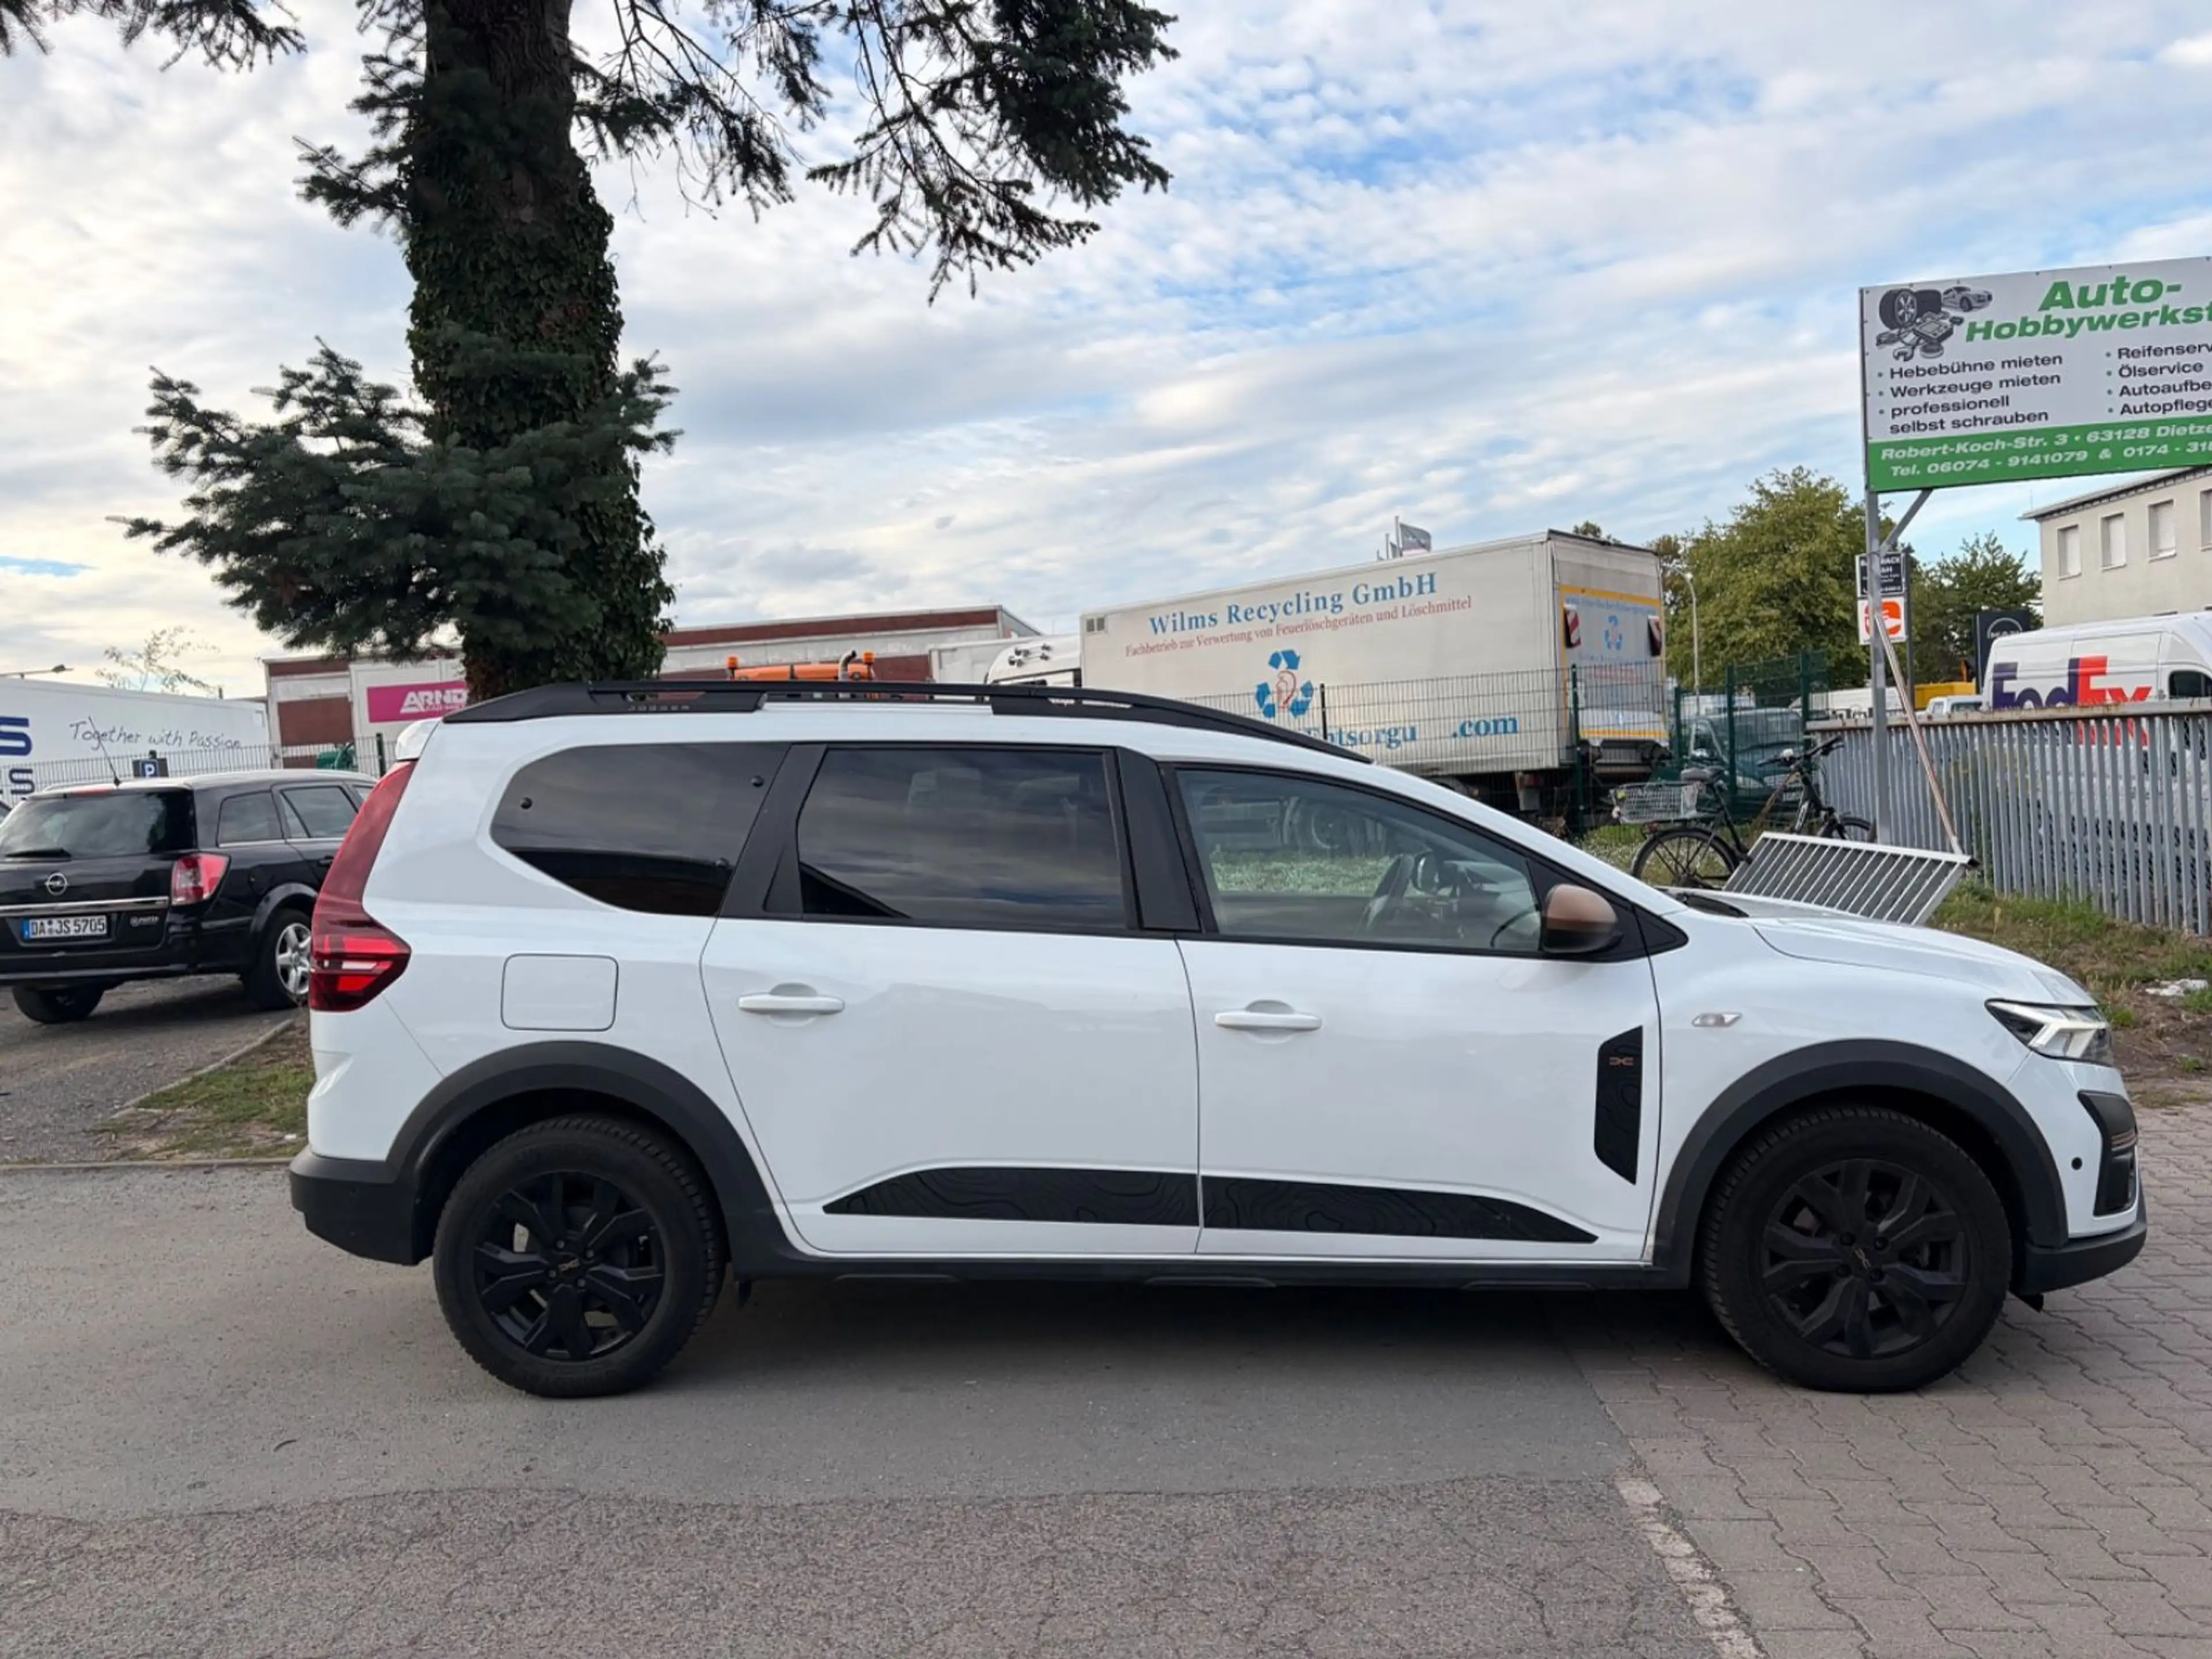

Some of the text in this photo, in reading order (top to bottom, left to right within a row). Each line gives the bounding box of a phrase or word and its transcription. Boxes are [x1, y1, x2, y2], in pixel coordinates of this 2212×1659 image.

[2038, 275, 2182, 311] Auto-
[1890, 355, 2063, 378] Hebebühne mieten
[2119, 361, 2203, 377] Ölservice
[1890, 374, 2061, 397] Werkzeuge mieten
[2119, 378, 2212, 397] Autoaufbe
[1891, 395, 2009, 419] professionell
[1889, 411, 2048, 434] selbst schrauben
[1881, 436, 2047, 460] Robert-Koch-Str.
[2054, 433, 2069, 446] 3
[2086, 427, 2150, 443] 63128
[1891, 464, 1921, 476] Tel.
[1927, 459, 1990, 474] 06074
[2008, 450, 2088, 467] 9141079
[2099, 448, 2112, 460] &
[2123, 444, 2169, 457] 0174
[1149, 572, 1437, 635] Wilms Recycling GmbH
[1126, 596, 1472, 657] Fachbetrieb zur Verwertung von Feuerlöschgeräten und Löschmittel
[69, 721, 241, 750] Together with Passion
[1452, 717, 1518, 738] .com
[145, 763, 156, 778] P
[31, 918, 105, 935] DA JS 5705
